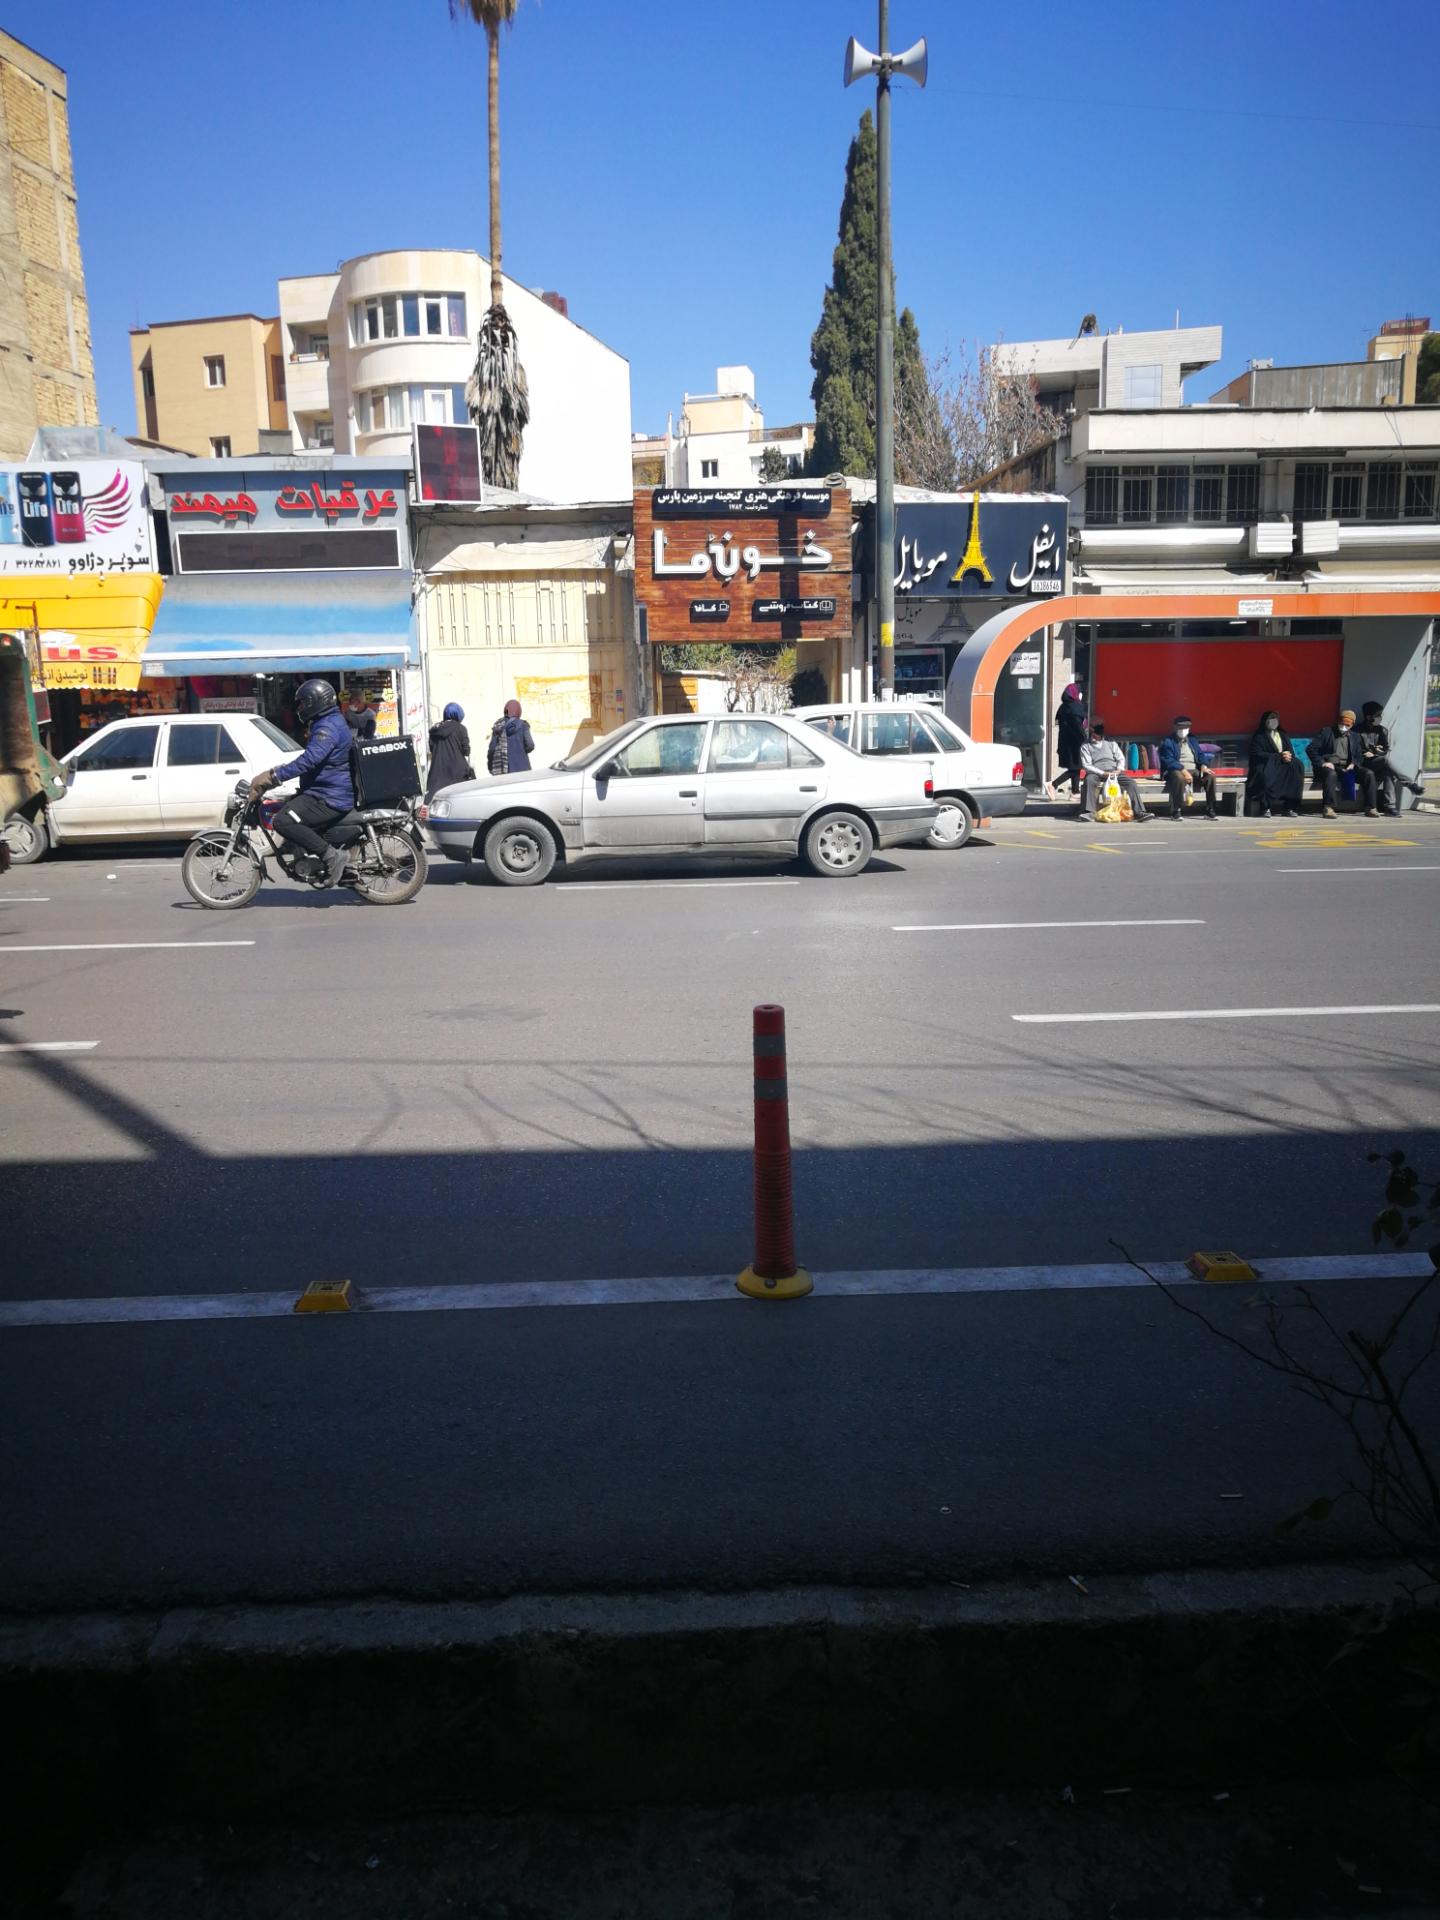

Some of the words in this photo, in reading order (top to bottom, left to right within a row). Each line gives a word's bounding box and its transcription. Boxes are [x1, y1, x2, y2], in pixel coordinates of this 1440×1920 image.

[274, 480, 398, 518] عرقیات
[657, 490, 681, 504] پارس
[682, 491, 714, 503] سرزمین
[715, 490, 743, 503] گنجینه
[745, 490, 768, 503] هنری
[768, 489, 801, 503] فرهنگی
[802, 491, 830, 503] موسسه
[24, 499, 49, 518] Life
[55, 497, 80, 515] Life
[654, 528, 712, 574] ما
[1010, 523, 1061, 588] ایفل
[108, 552, 149, 572] سوپر
[893, 534, 948, 590] موبایل
[694, 603, 717, 612] کافه
[55, 668, 88, 683] نوشیدنی
